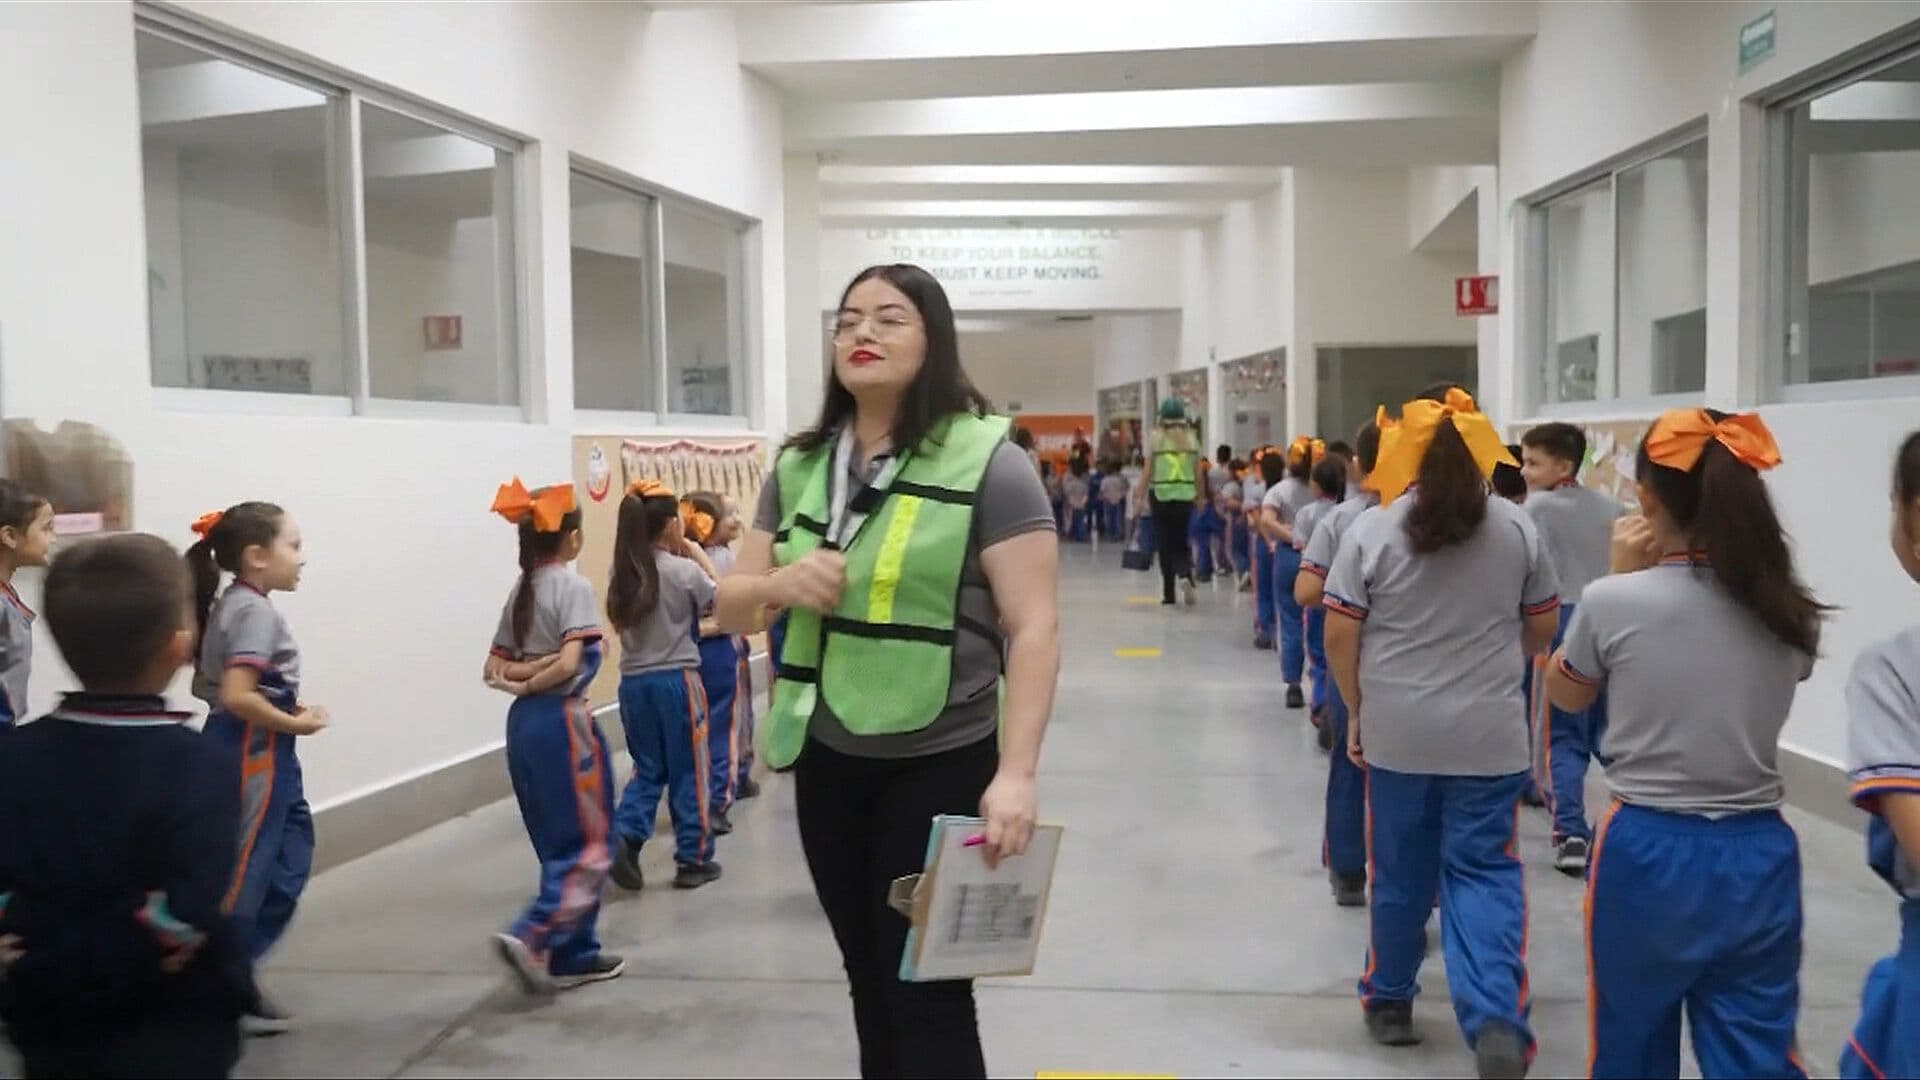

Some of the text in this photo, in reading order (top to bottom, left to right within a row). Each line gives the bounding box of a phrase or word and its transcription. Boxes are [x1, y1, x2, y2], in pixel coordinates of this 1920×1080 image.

[889, 246, 912, 260] TO
[917, 246, 963, 260] KEEP
[967, 246, 1013, 260] YOUR
[931, 266, 1103, 280] MUST KEEP MOVING.
